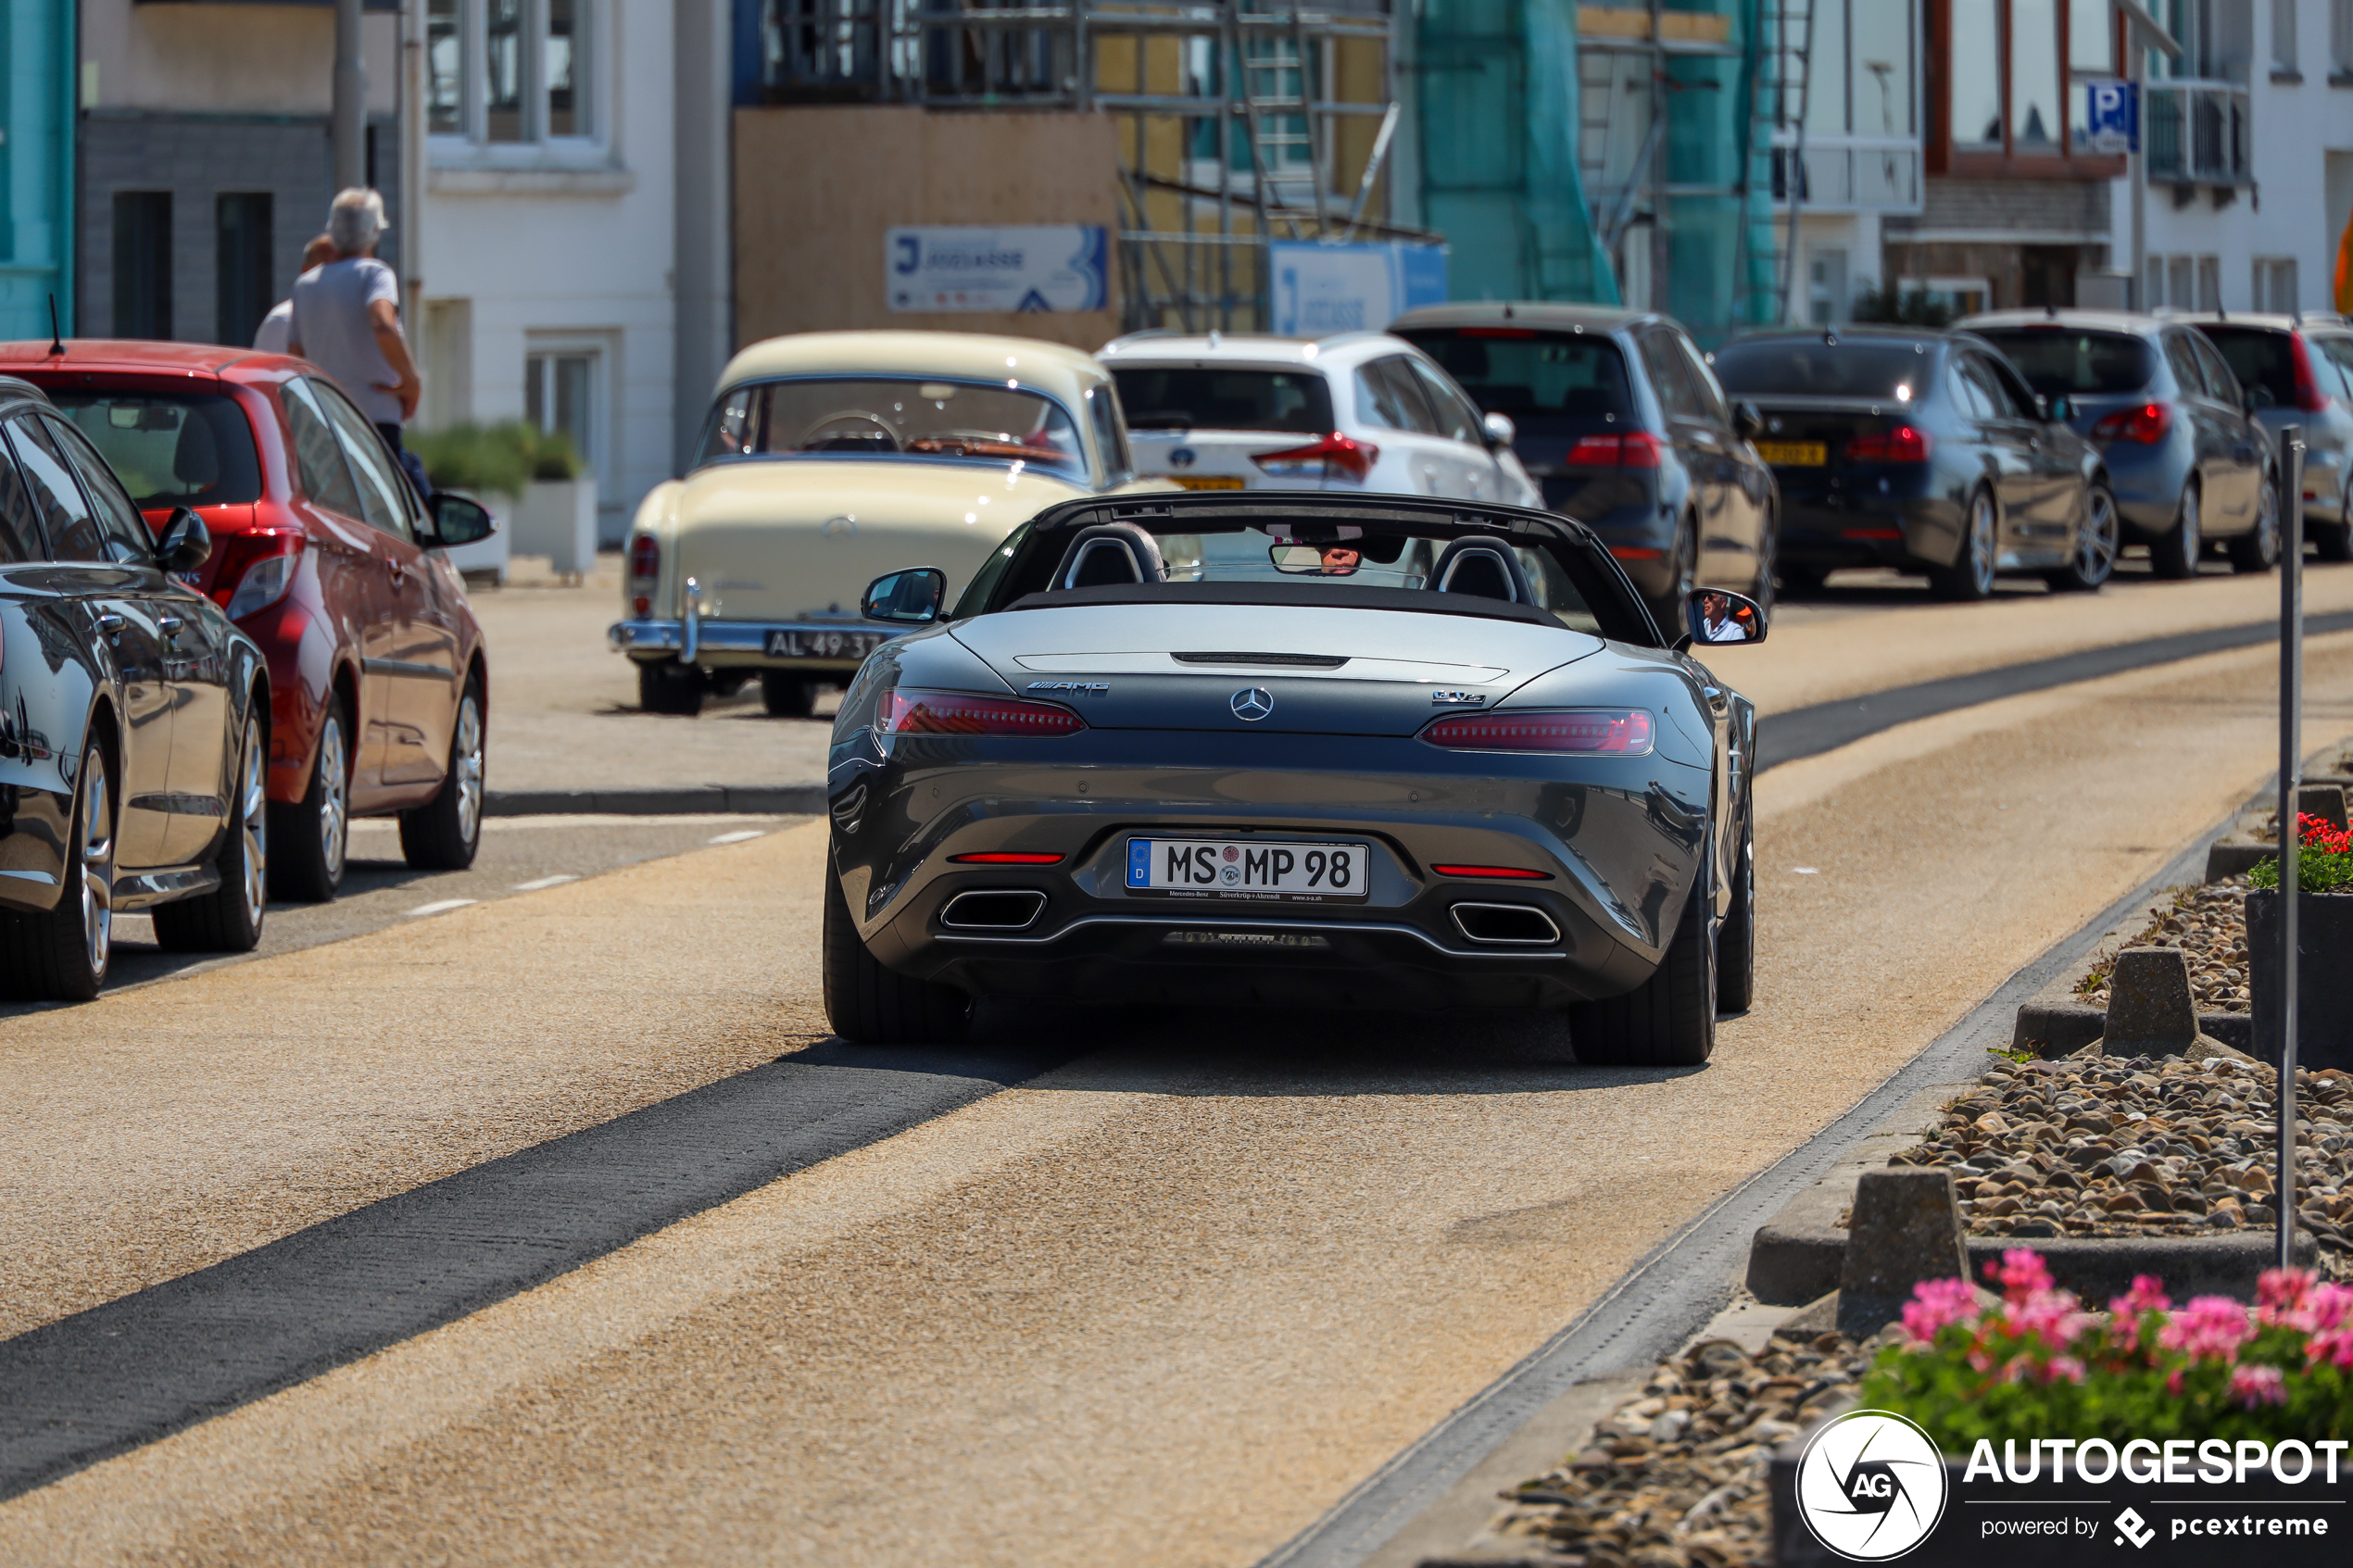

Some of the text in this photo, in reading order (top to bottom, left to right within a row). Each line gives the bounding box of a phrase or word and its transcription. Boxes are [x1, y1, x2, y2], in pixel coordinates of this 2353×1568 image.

[2095, 86, 2121, 123] P
[1052, 682, 1110, 691] AMG
[1136, 868, 1144, 879] D
[1167, 847, 1216, 884] MS
[1244, 848, 1294, 885] MP
[1304, 850, 1351, 888] 98
